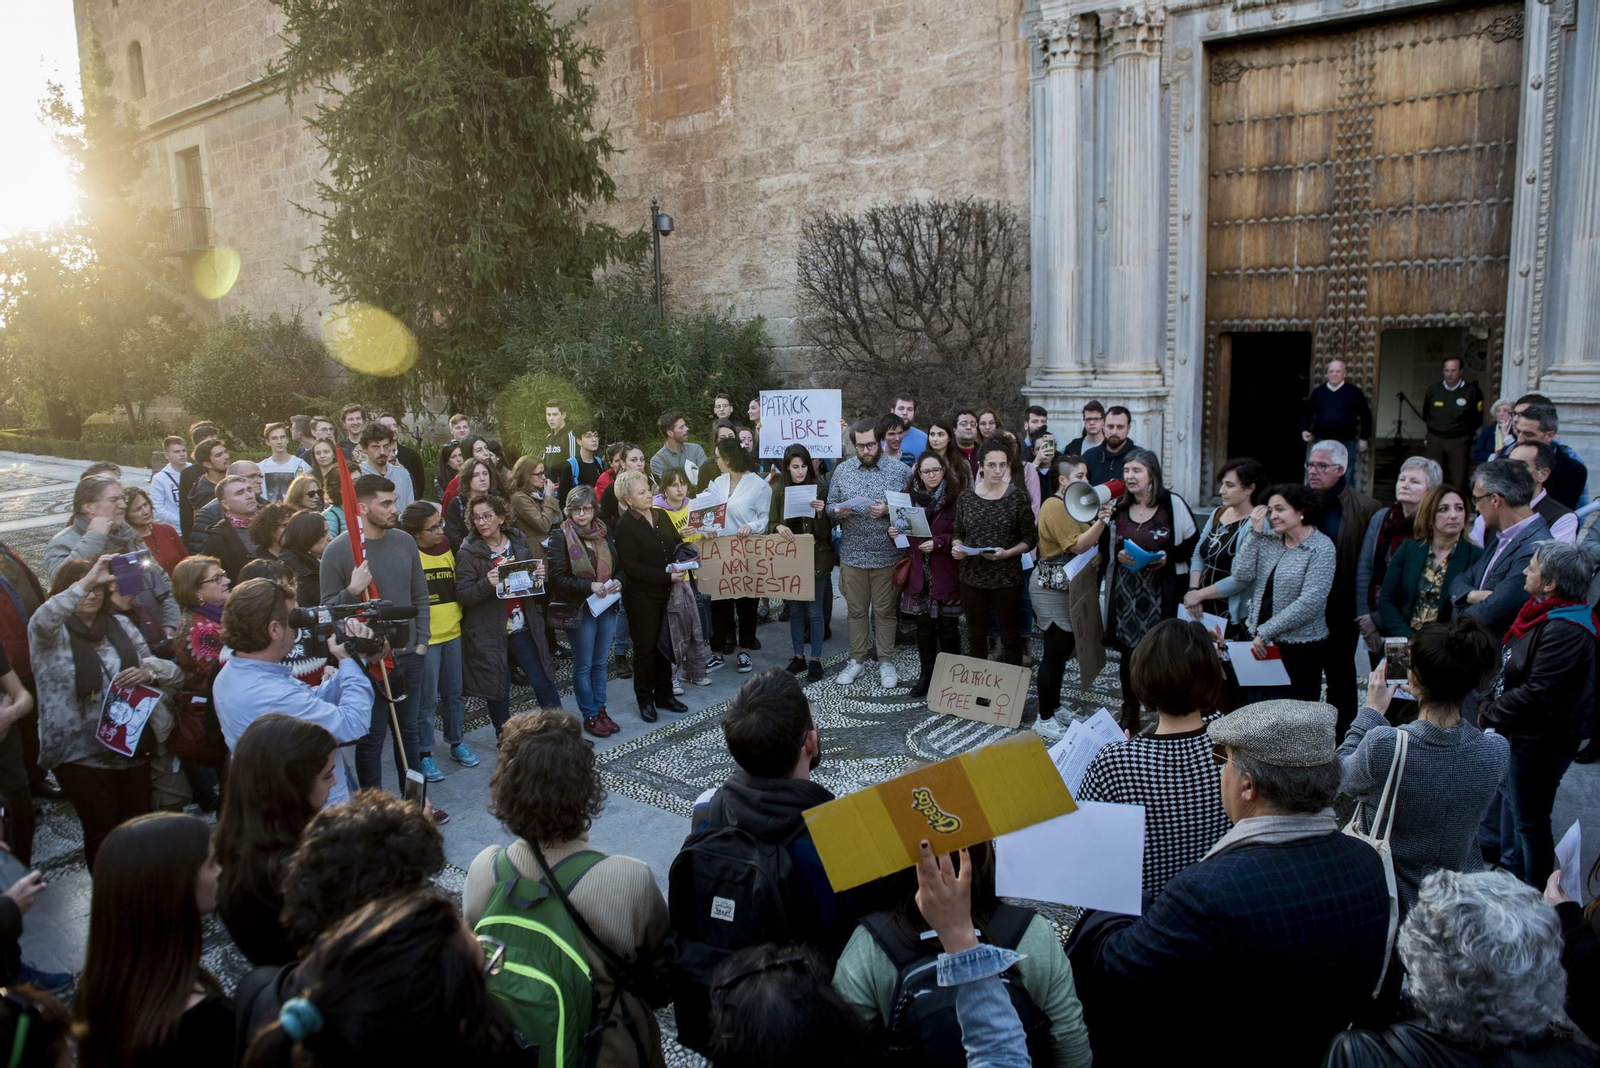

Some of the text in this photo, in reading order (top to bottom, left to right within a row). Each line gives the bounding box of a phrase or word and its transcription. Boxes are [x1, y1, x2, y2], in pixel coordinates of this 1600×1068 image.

[701, 538, 797, 560] LA RICERCA
[718, 574, 801, 596] ARRESTA
[938, 686, 973, 710] FREE
[912, 787, 961, 834] Cheetos
